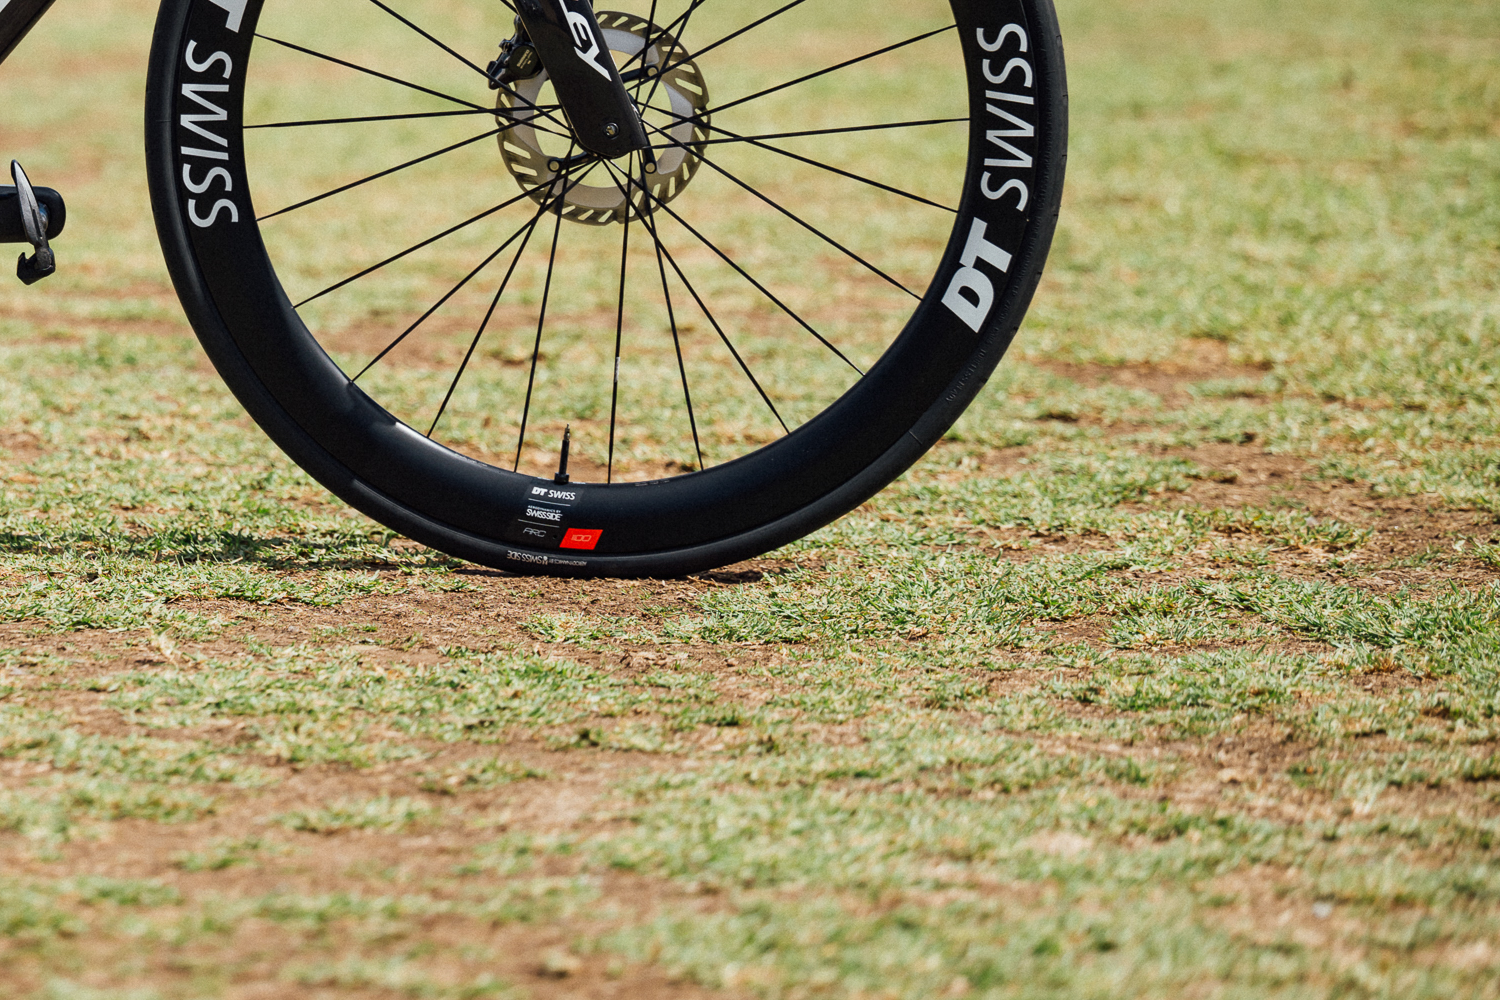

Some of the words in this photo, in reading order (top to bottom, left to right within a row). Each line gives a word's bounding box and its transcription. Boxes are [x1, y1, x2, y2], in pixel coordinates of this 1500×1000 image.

[976, 21, 1036, 213] SWISS
[179, 39, 240, 229] SWISS
[941, 216, 1013, 333] DT
[531, 487, 547, 496] DT
[548, 490, 576, 500] SWISS
[523, 527, 546, 537] ARC
[506, 550, 522, 561] SIDE
[522, 553, 543, 563] SWISS
